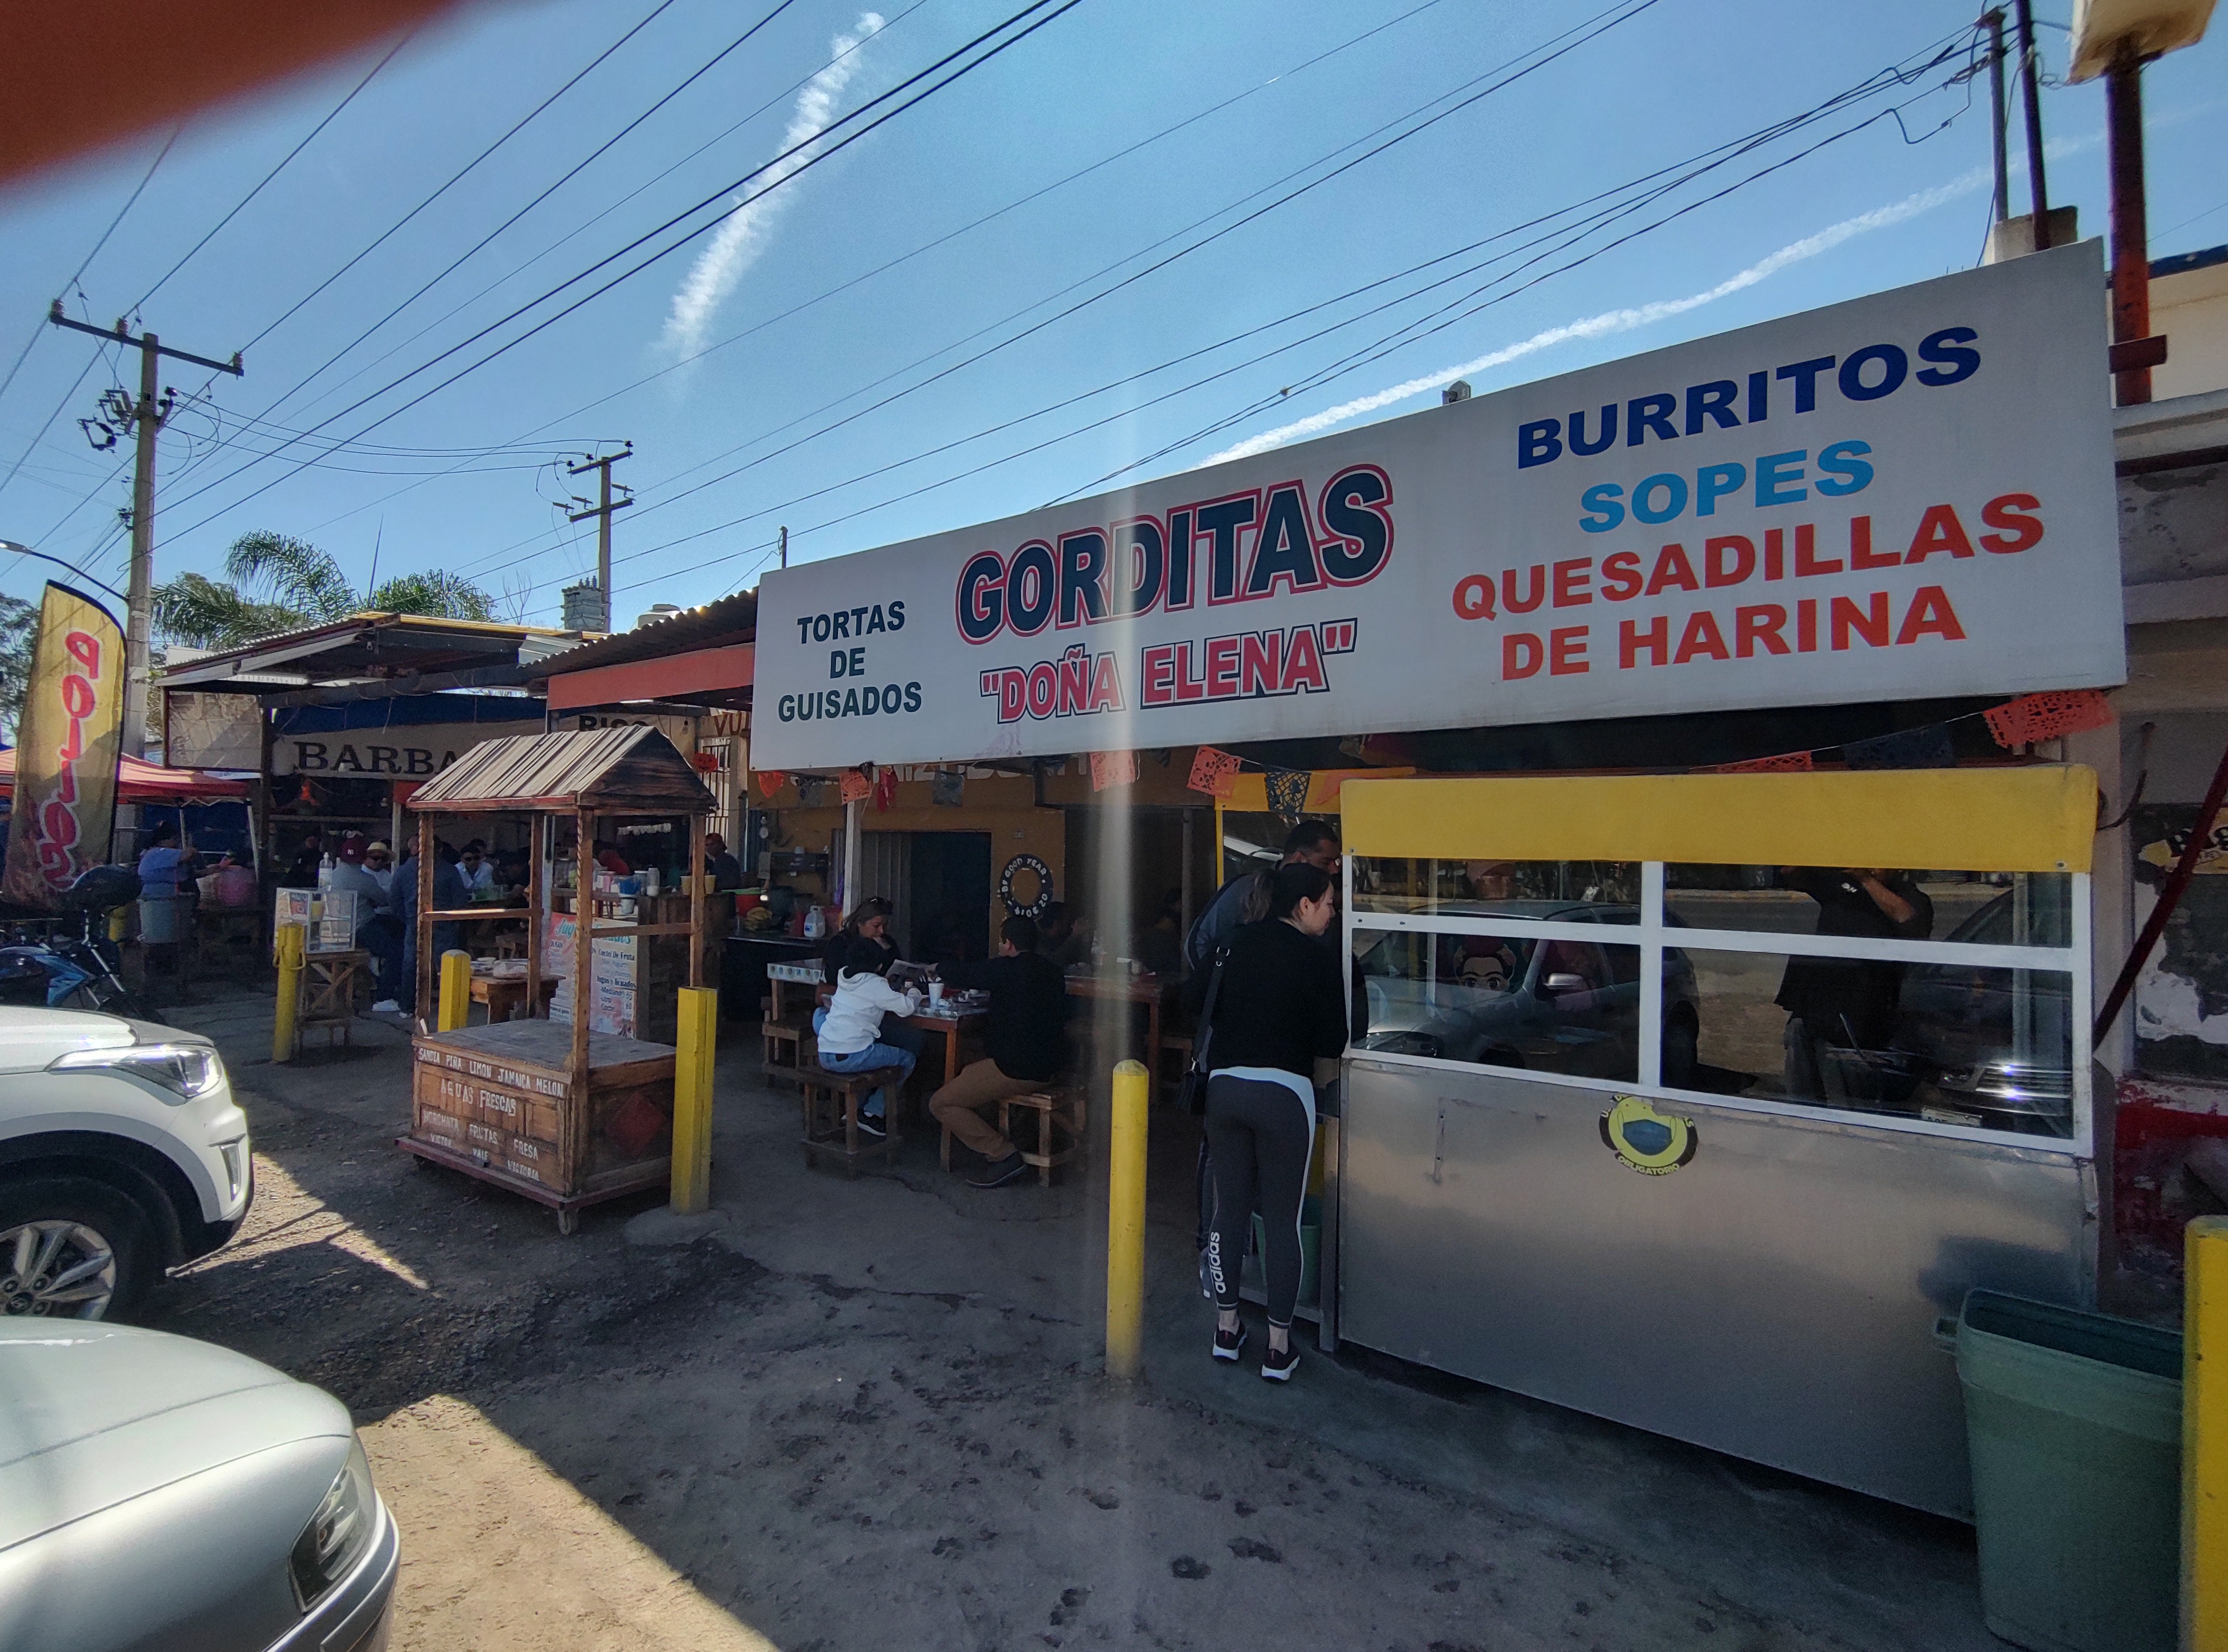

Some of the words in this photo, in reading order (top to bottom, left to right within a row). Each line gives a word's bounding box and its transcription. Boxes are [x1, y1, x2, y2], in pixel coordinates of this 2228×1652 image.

[1518, 327, 1981, 470] BURRITOS
[1579, 439, 1874, 533] SOPES
[956, 464, 1394, 645] GORDITAS
[1452, 493, 2045, 622] QUESADILLAS
[797, 601, 905, 644] TORTAS
[1502, 626, 1589, 681] DE
[1619, 586, 1967, 669] HARINA
[830, 647, 865, 678] DE
[981, 642, 1126, 723] "DOÑA
[1140, 617, 1358, 710] ELENA"
[778, 681, 921, 722] GUISADOS
[556, 919, 577, 939] Jug
[621, 952, 635, 961] Fruta
[419, 1048, 440, 1063] SANDIA
[446, 1055, 462, 1070] PIÑA
[470, 1061, 491, 1078] LIMON
[498, 1069, 531, 1089] JAMAICA
[536, 1078, 563, 1097] MELON
[441, 1078, 473, 1104] AGUAS
[480, 1090, 516, 1116] FRESCAS
[469, 1124, 498, 1144] FRUTAS
[514, 1139, 538, 1161] FRESA
[1618, 1155, 1680, 1175] OBLIGATORIO
[1209, 1232, 1226, 1294] adidas
